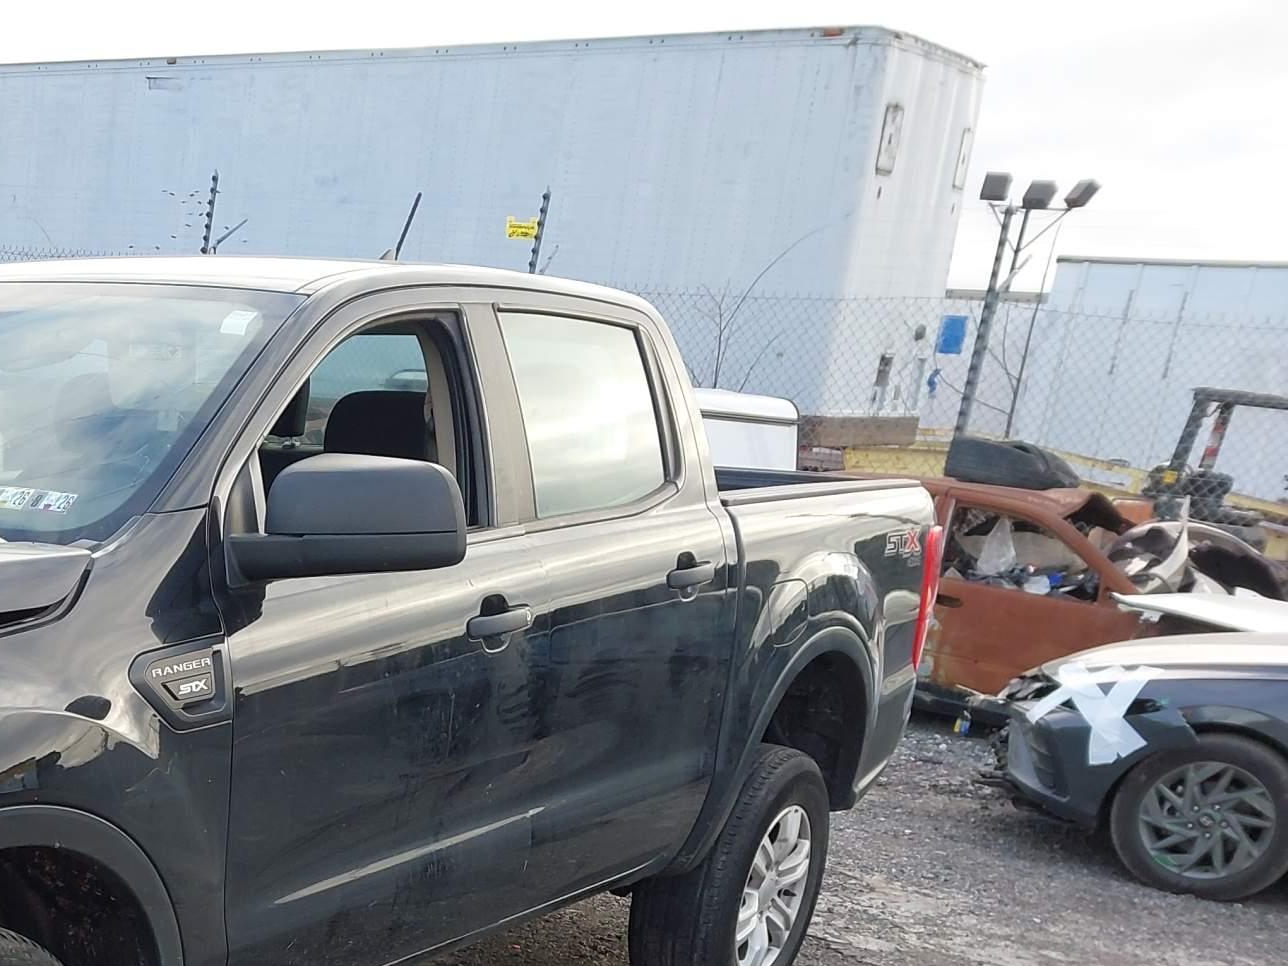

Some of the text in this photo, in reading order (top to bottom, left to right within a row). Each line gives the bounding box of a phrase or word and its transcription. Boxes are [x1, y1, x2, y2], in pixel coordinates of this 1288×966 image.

[884, 529, 921, 558] STX
[152, 657, 211, 678] RANGER
[177, 679, 208, 695] STX
